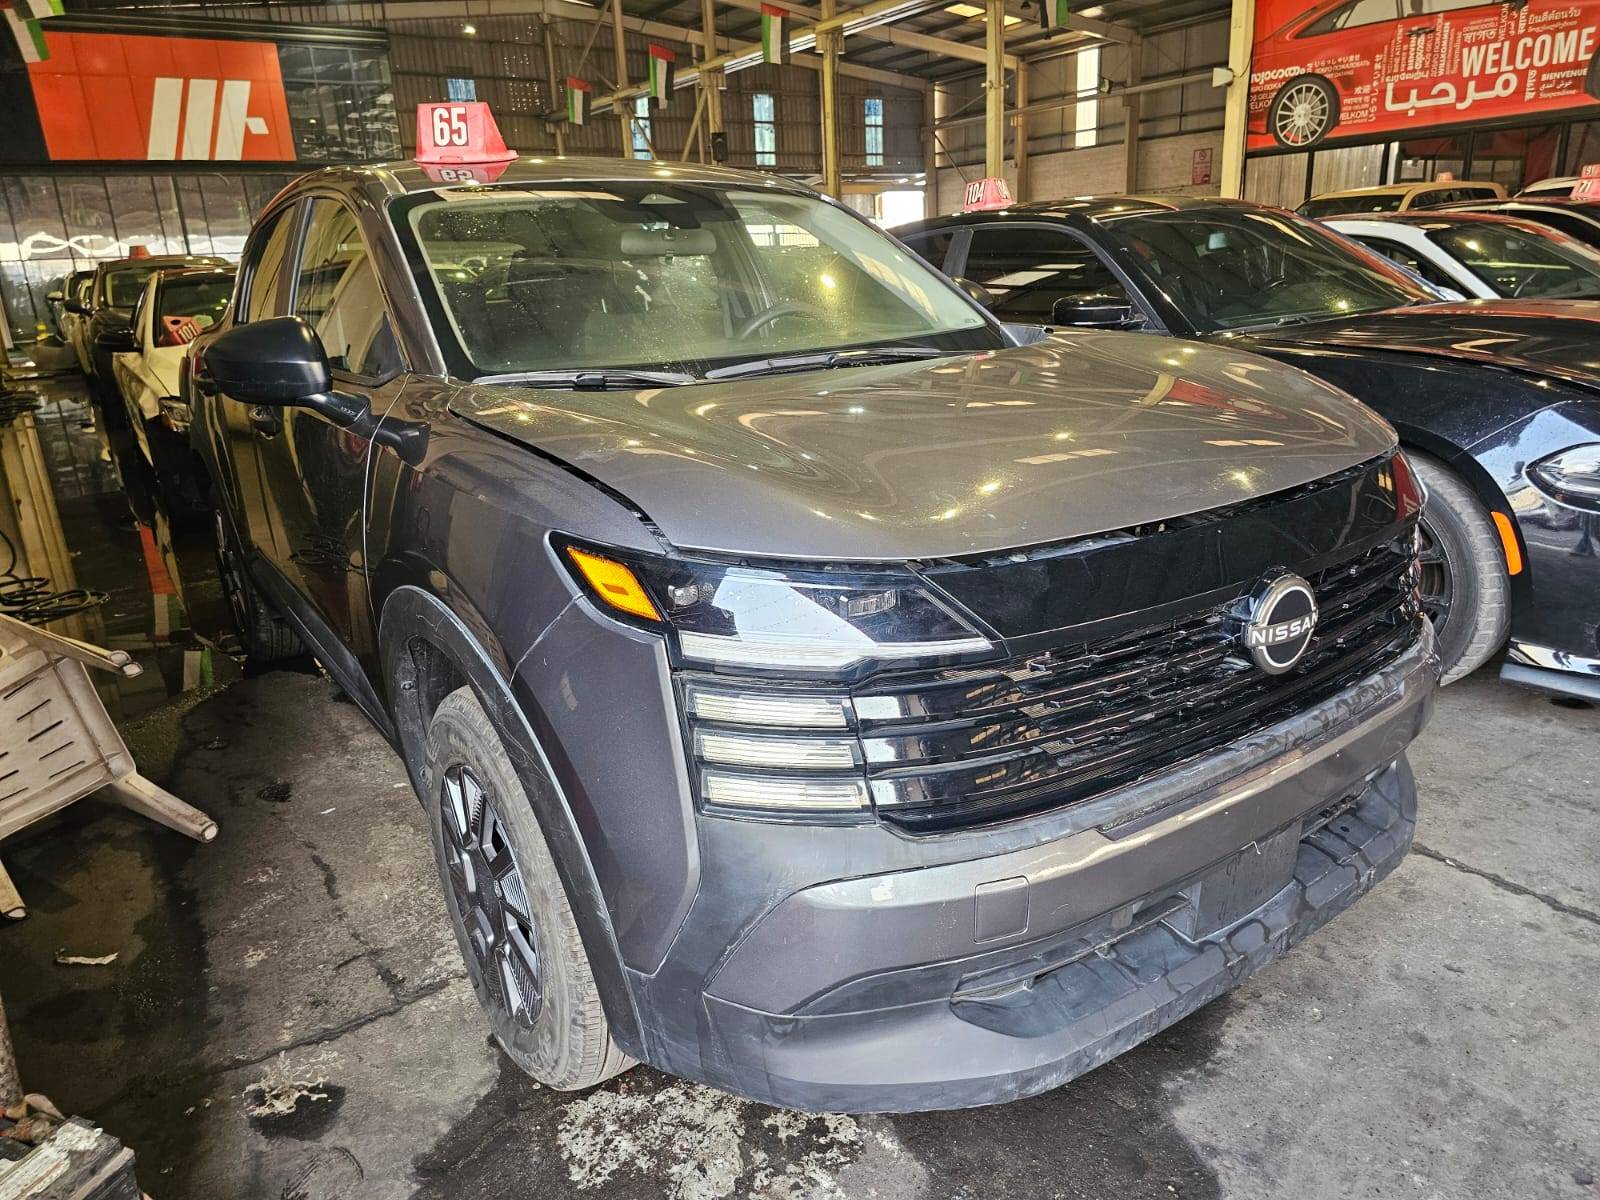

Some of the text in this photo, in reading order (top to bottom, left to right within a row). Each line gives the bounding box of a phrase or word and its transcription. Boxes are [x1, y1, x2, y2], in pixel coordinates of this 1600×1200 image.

[1462, 26, 1597, 78] WELCOME
[1541, 68, 1588, 81] BIENVENUE
[1385, 72, 1517, 117] مرحبا
[433, 107, 468, 146] 65
[968, 181, 985, 205] 104
[179, 322, 197, 342] 101
[1252, 611, 1318, 644] NISSAN
